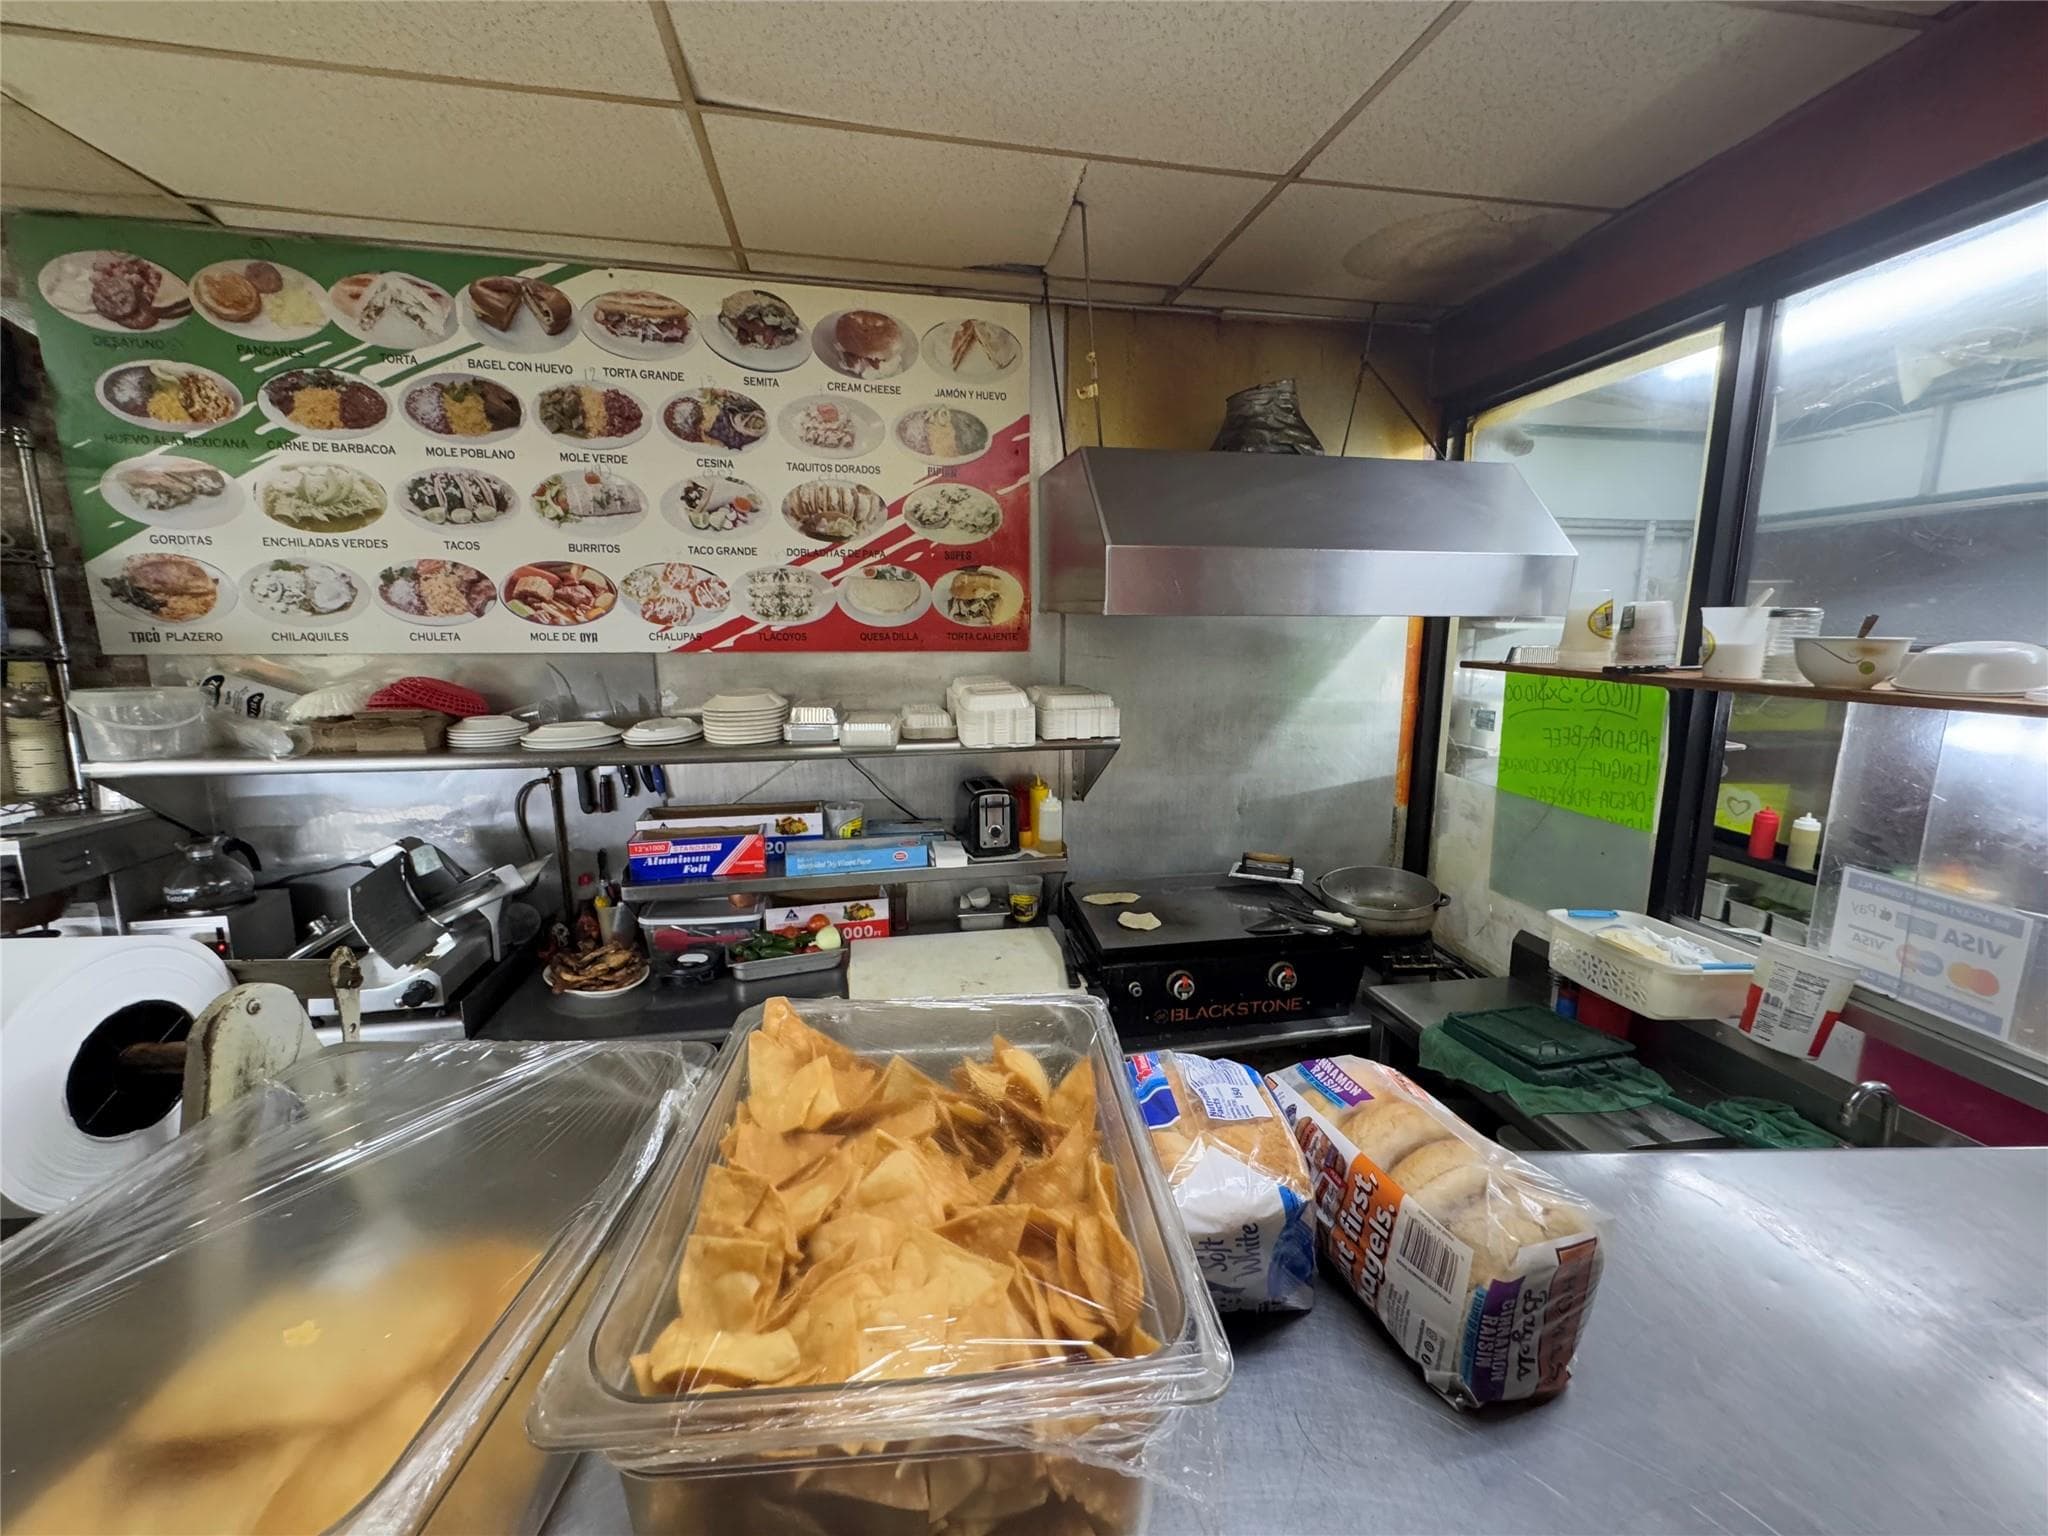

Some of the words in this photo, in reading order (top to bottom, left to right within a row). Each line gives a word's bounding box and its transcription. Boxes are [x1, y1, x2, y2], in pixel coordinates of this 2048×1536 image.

[92, 335, 164, 350] DESAYUNO
[236, 343, 305, 358] PANCAKES
[380, 353, 418, 365] TORTA
[468, 358, 506, 371] BAGEL
[507, 361, 533, 372] CON
[535, 362, 573, 375] HUEVO
[602, 367, 638, 379] TORTA
[639, 369, 685, 382] GRANDE
[743, 376, 780, 388] SEMITA
[827, 381, 862, 393] CREAM
[864, 384, 902, 395] CHEESE
[935, 387, 967, 399] JAMÓN
[968, 390, 974, 399] Y
[976, 391, 1007, 401] HUEVO
[104, 433, 149, 446] HUEVO
[183, 436, 249, 450] MEXICANA
[267, 440, 310, 452] CARNE
[312, 441, 330, 453] DE
[332, 442, 397, 455] BARBACOA
[426, 446, 459, 458] MOLE
[460, 448, 516, 460] POBLANO
[559, 453, 590, 463] MOLE
[592, 454, 628, 465] VERDE
[696, 458, 735, 469] CESINA
[786, 462, 833, 473] TAQUITOS
[834, 463, 881, 475] DORADOS
[150, 534, 213, 546] GORDITAS
[262, 536, 340, 549] ENCHILADAS
[341, 538, 389, 549] VERDES
[443, 540, 481, 551] TACOS
[568, 543, 621, 553] BURRITOS
[687, 546, 714, 556] TACO
[716, 546, 758, 557] GRANDE
[786, 548, 846, 558] DOBLADITAS
[847, 549, 861, 558] DE
[862, 549, 887, 559] PAPA
[129, 630, 161, 643] TACO
[165, 631, 223, 642] PLAZERO
[271, 631, 349, 642] CHILAQUILES
[409, 632, 461, 642] CHULETA
[530, 632, 559, 642] MOLE
[561, 632, 577, 642] DE
[648, 632, 703, 642] CHALUPAS
[758, 632, 808, 642] TLACOYOS
[859, 632, 890, 643] QUESA
[892, 632, 919, 642] DILLA
[946, 631, 976, 642] TORTA
[976, 632, 1019, 642] CALIENTE
[643, 853, 711, 867] Aluminum
[683, 864, 707, 874] Foil
[1171, 997, 1304, 1023] BLACKSTONE
[1310, 1064, 1345, 1095] RAISIN
[1315, 1058, 1362, 1098] NNAMON
[1340, 1172, 1379, 1243] first,
[1195, 1238, 1232, 1273] Soft
[1227, 1222, 1263, 1283] White
[1475, 1314, 1500, 1369] RAISIN
[1491, 1299, 1517, 1382] CINNAMON
[1512, 1289, 1548, 1382] Bagels
